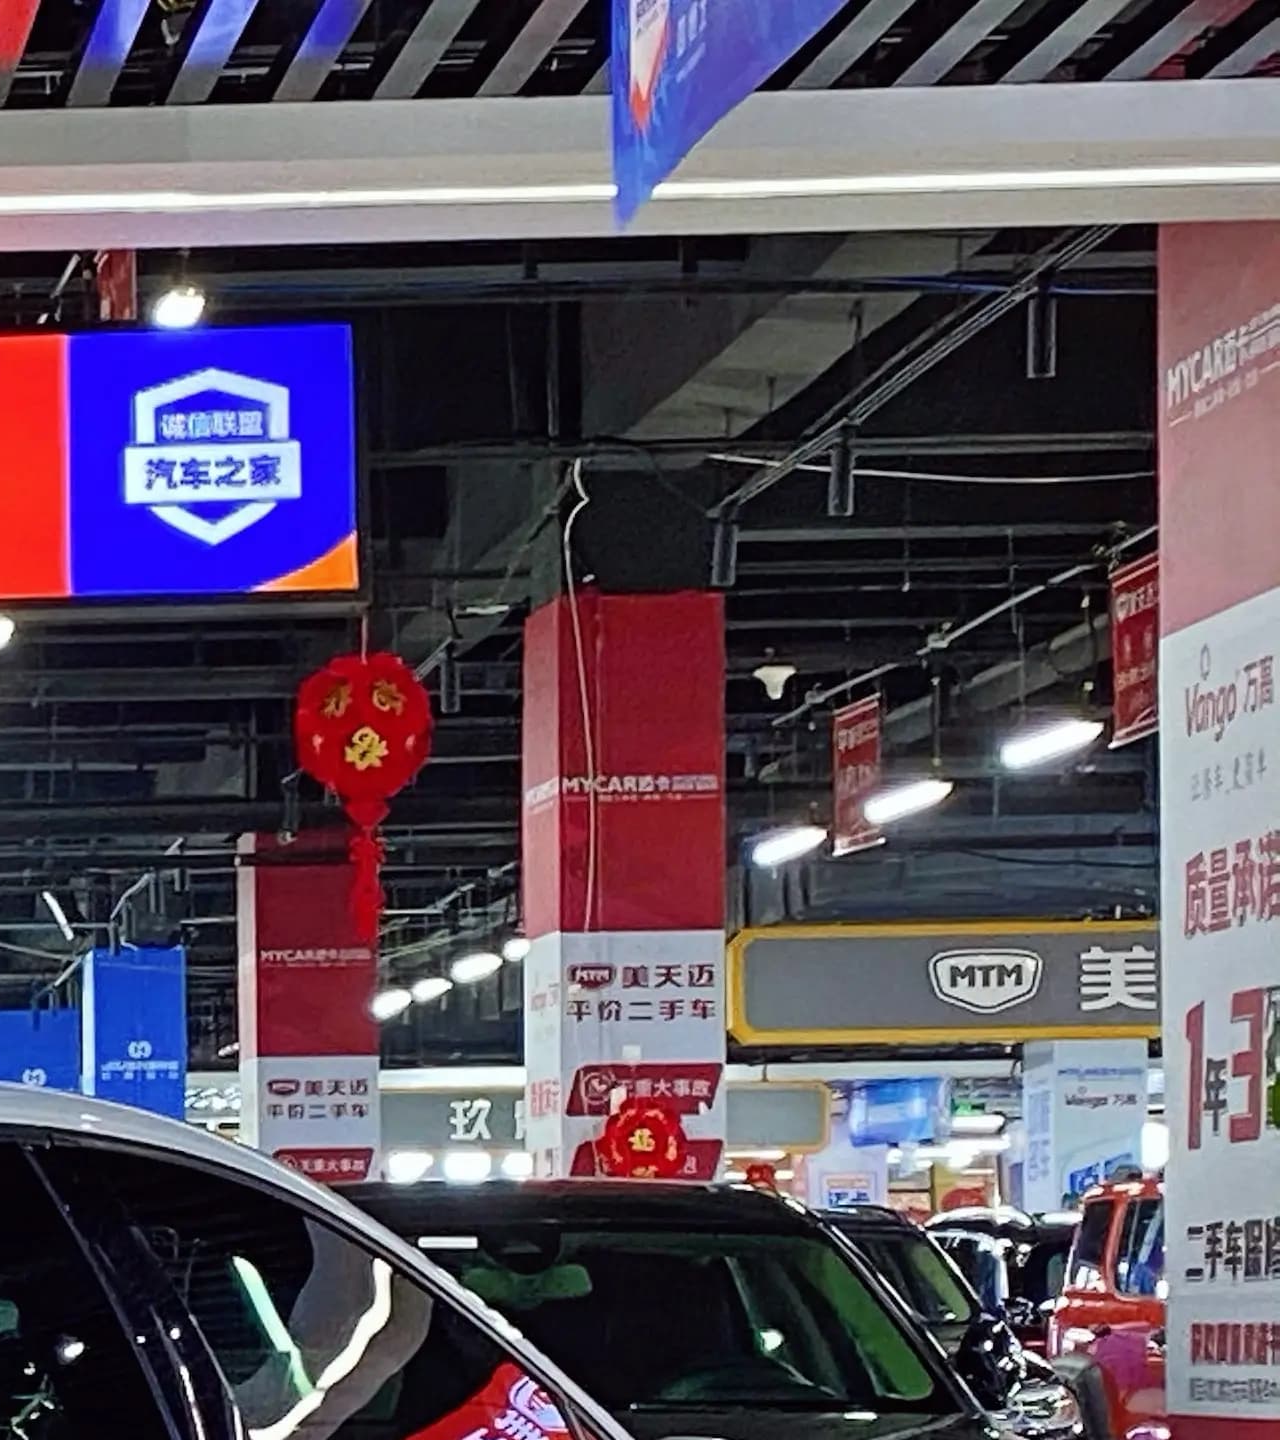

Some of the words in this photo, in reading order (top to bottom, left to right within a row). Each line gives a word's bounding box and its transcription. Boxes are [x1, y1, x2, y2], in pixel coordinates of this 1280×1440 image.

[145, 455, 281, 490] 汽车之家
[949, 964, 1024, 988] MTM
[1079, 945, 1158, 1012] 美
[566, 1000, 715, 1022] 平价二手车
